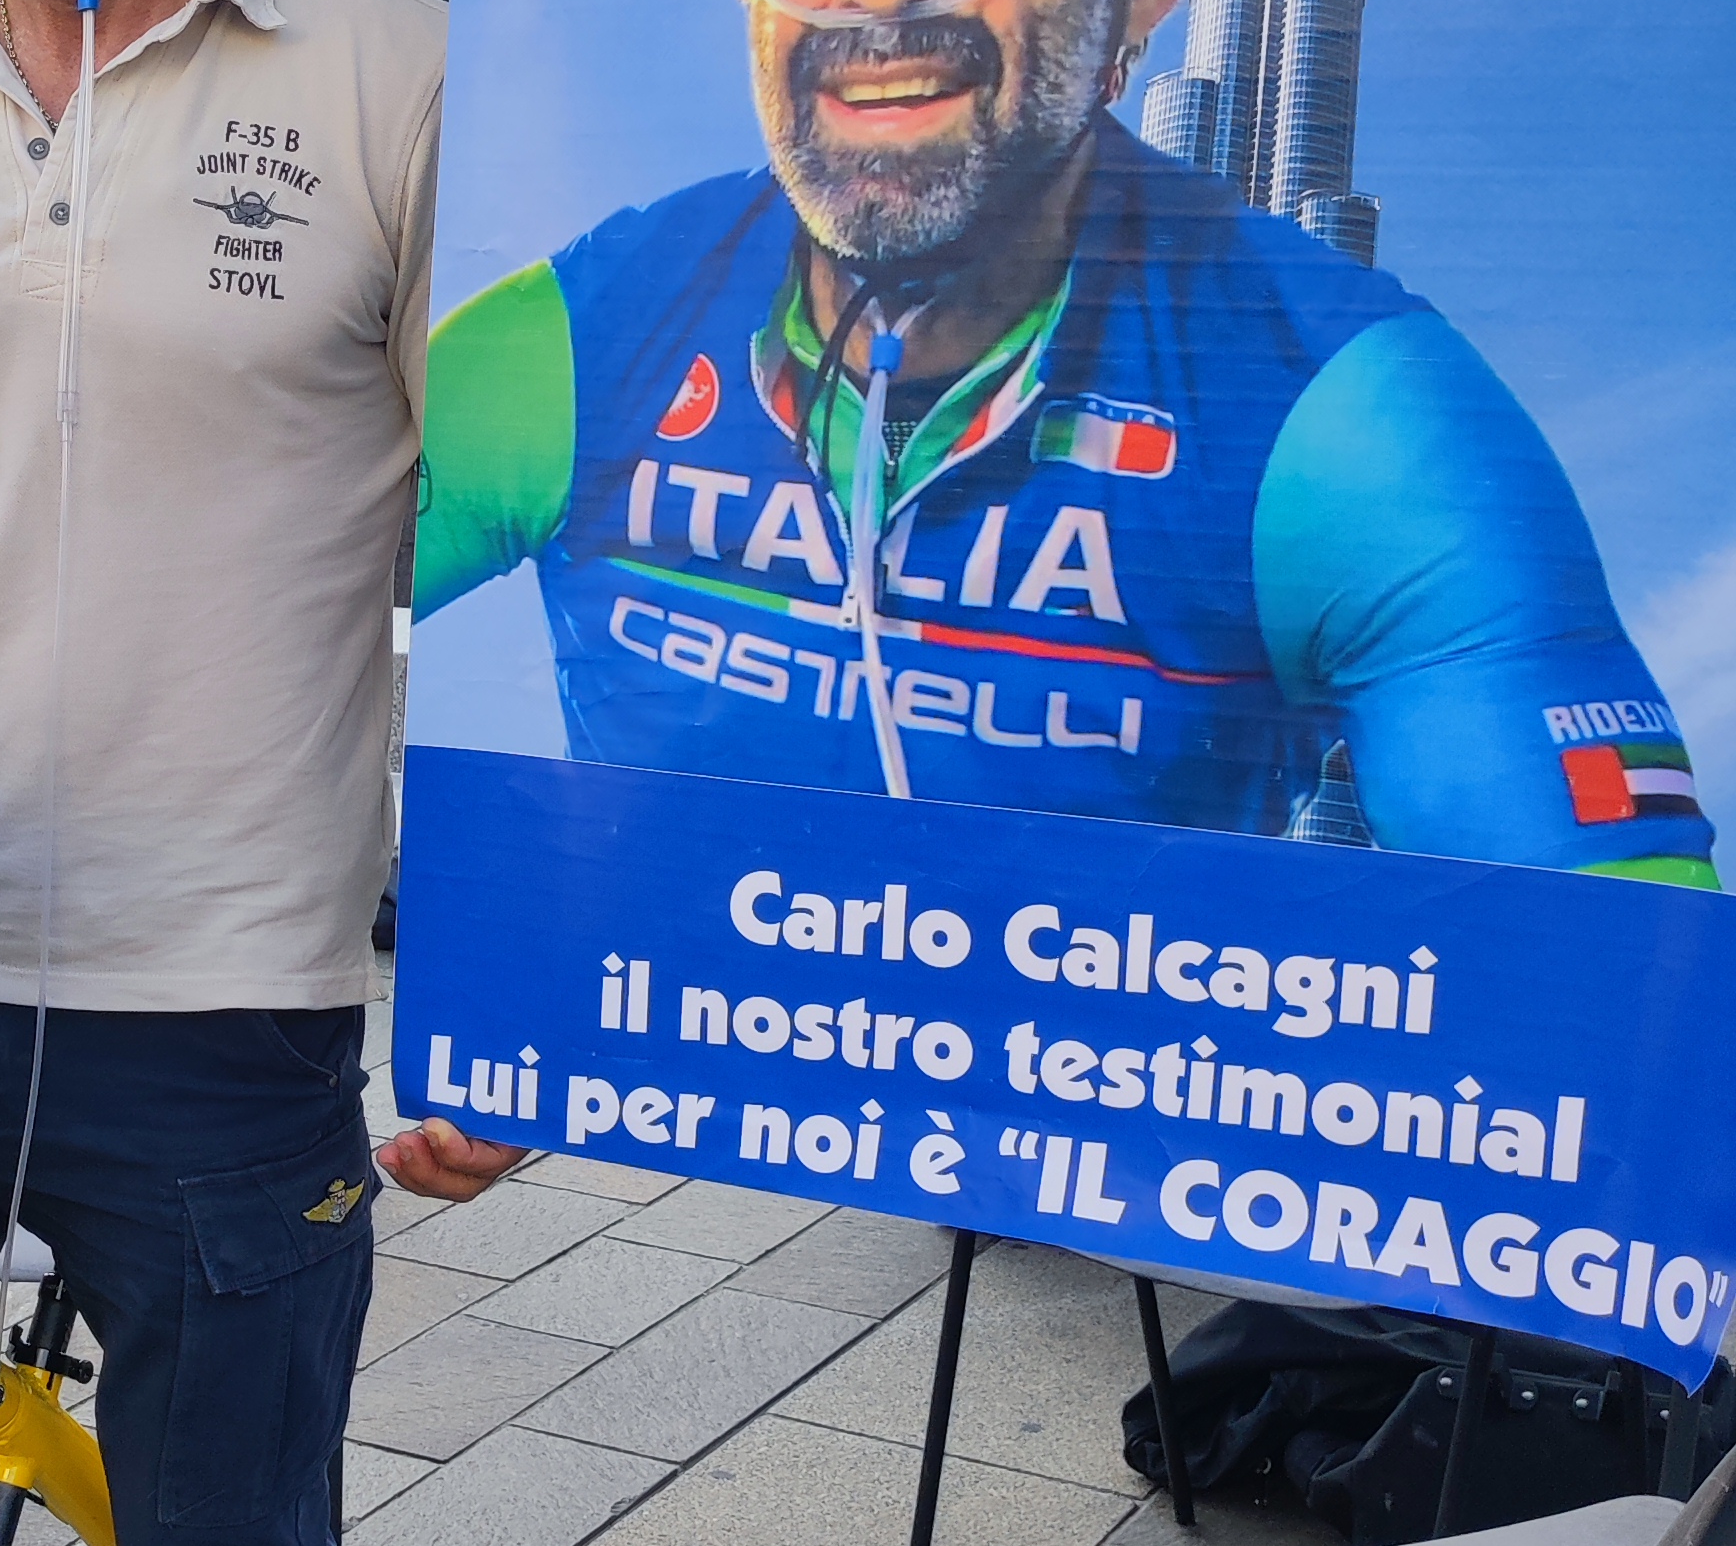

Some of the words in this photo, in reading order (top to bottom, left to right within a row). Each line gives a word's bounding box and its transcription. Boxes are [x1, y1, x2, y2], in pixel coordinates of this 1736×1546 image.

[196, 151, 250, 175] JOINT
[255, 156, 322, 197] STRIKE
[225, 120, 276, 148] F-35
[284, 128, 300, 153] B
[208, 267, 285, 301] STOVL
[213, 234, 283, 262] FIGHTER
[627, 458, 1128, 626] ITALIA
[729, 870, 972, 968] Carlo
[1003, 903, 1439, 1039] Calcagni
[424, 1035, 538, 1121] Lui
[566, 1072, 716, 1149] per
[739, 1100, 884, 1180] noi
[908, 1110, 962, 1196] è
[599, 952, 650, 1034] il
[680, 985, 973, 1082] nostro
[1003, 1019, 1587, 1185] testimonial
